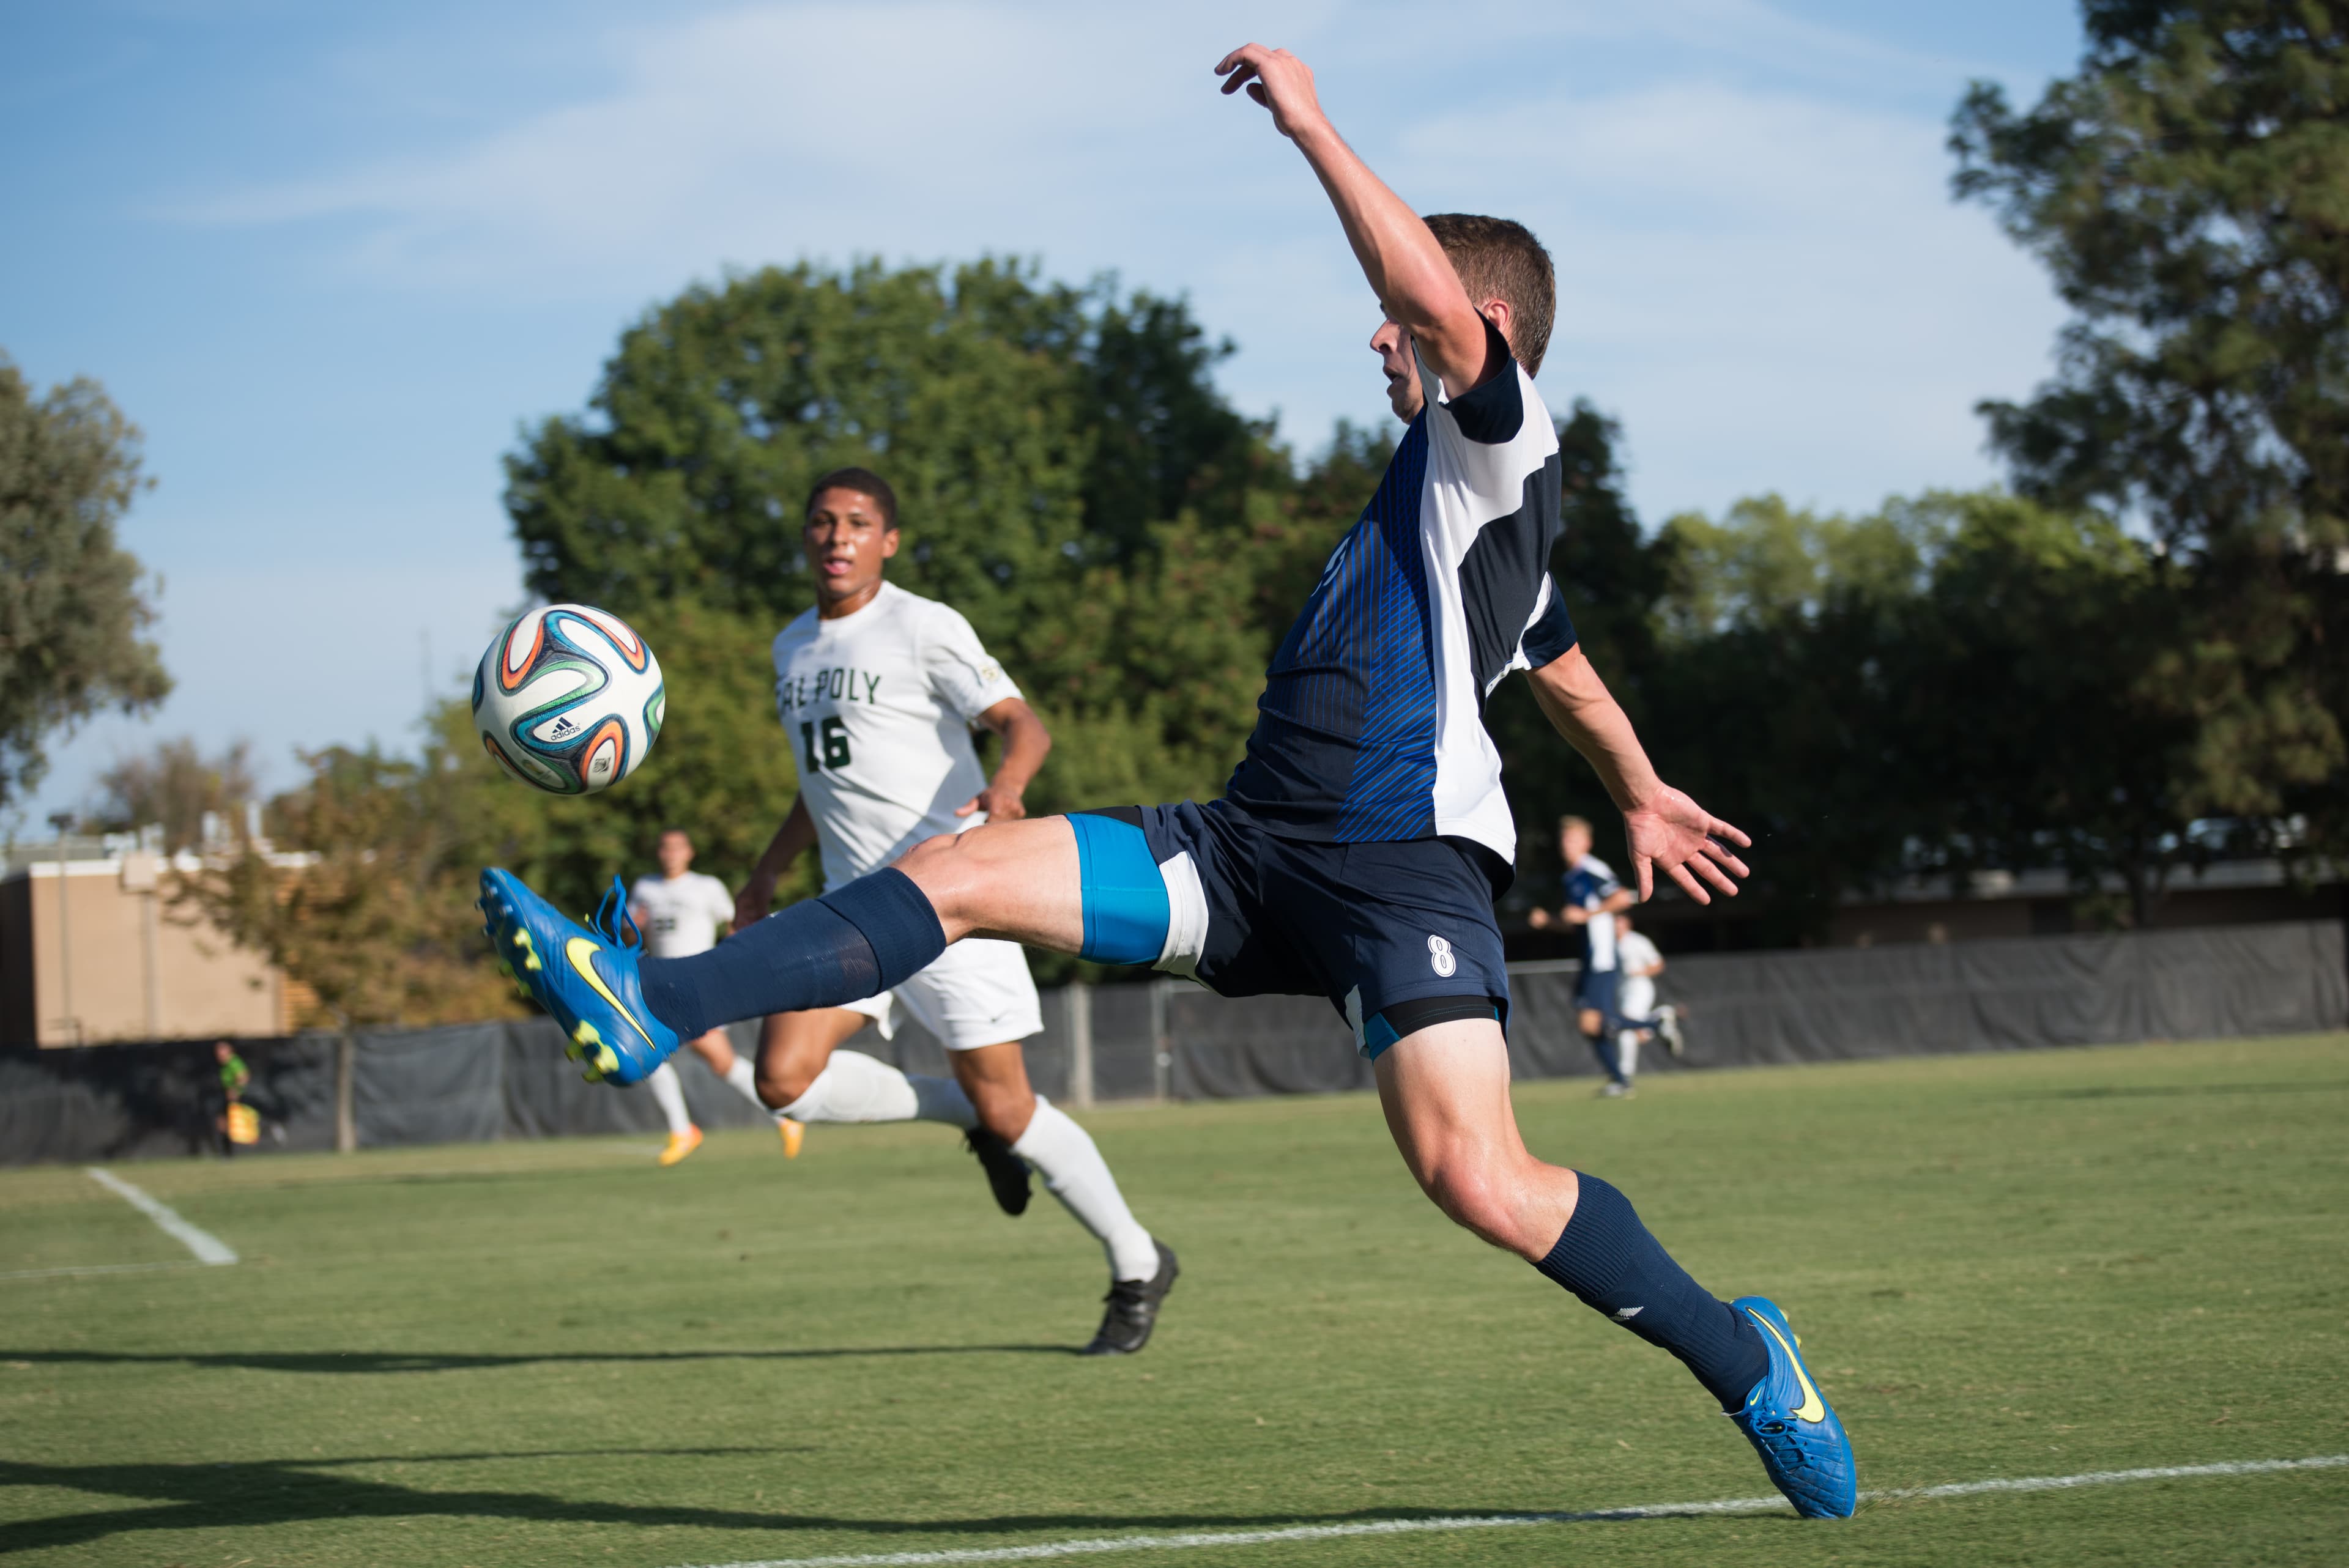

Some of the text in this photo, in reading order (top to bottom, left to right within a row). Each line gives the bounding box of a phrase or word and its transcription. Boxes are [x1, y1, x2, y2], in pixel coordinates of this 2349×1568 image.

[814, 668, 880, 704] POLY
[551, 726, 581, 741] adidas
[801, 716, 851, 773] 16
[1427, 934, 1457, 977] 8
